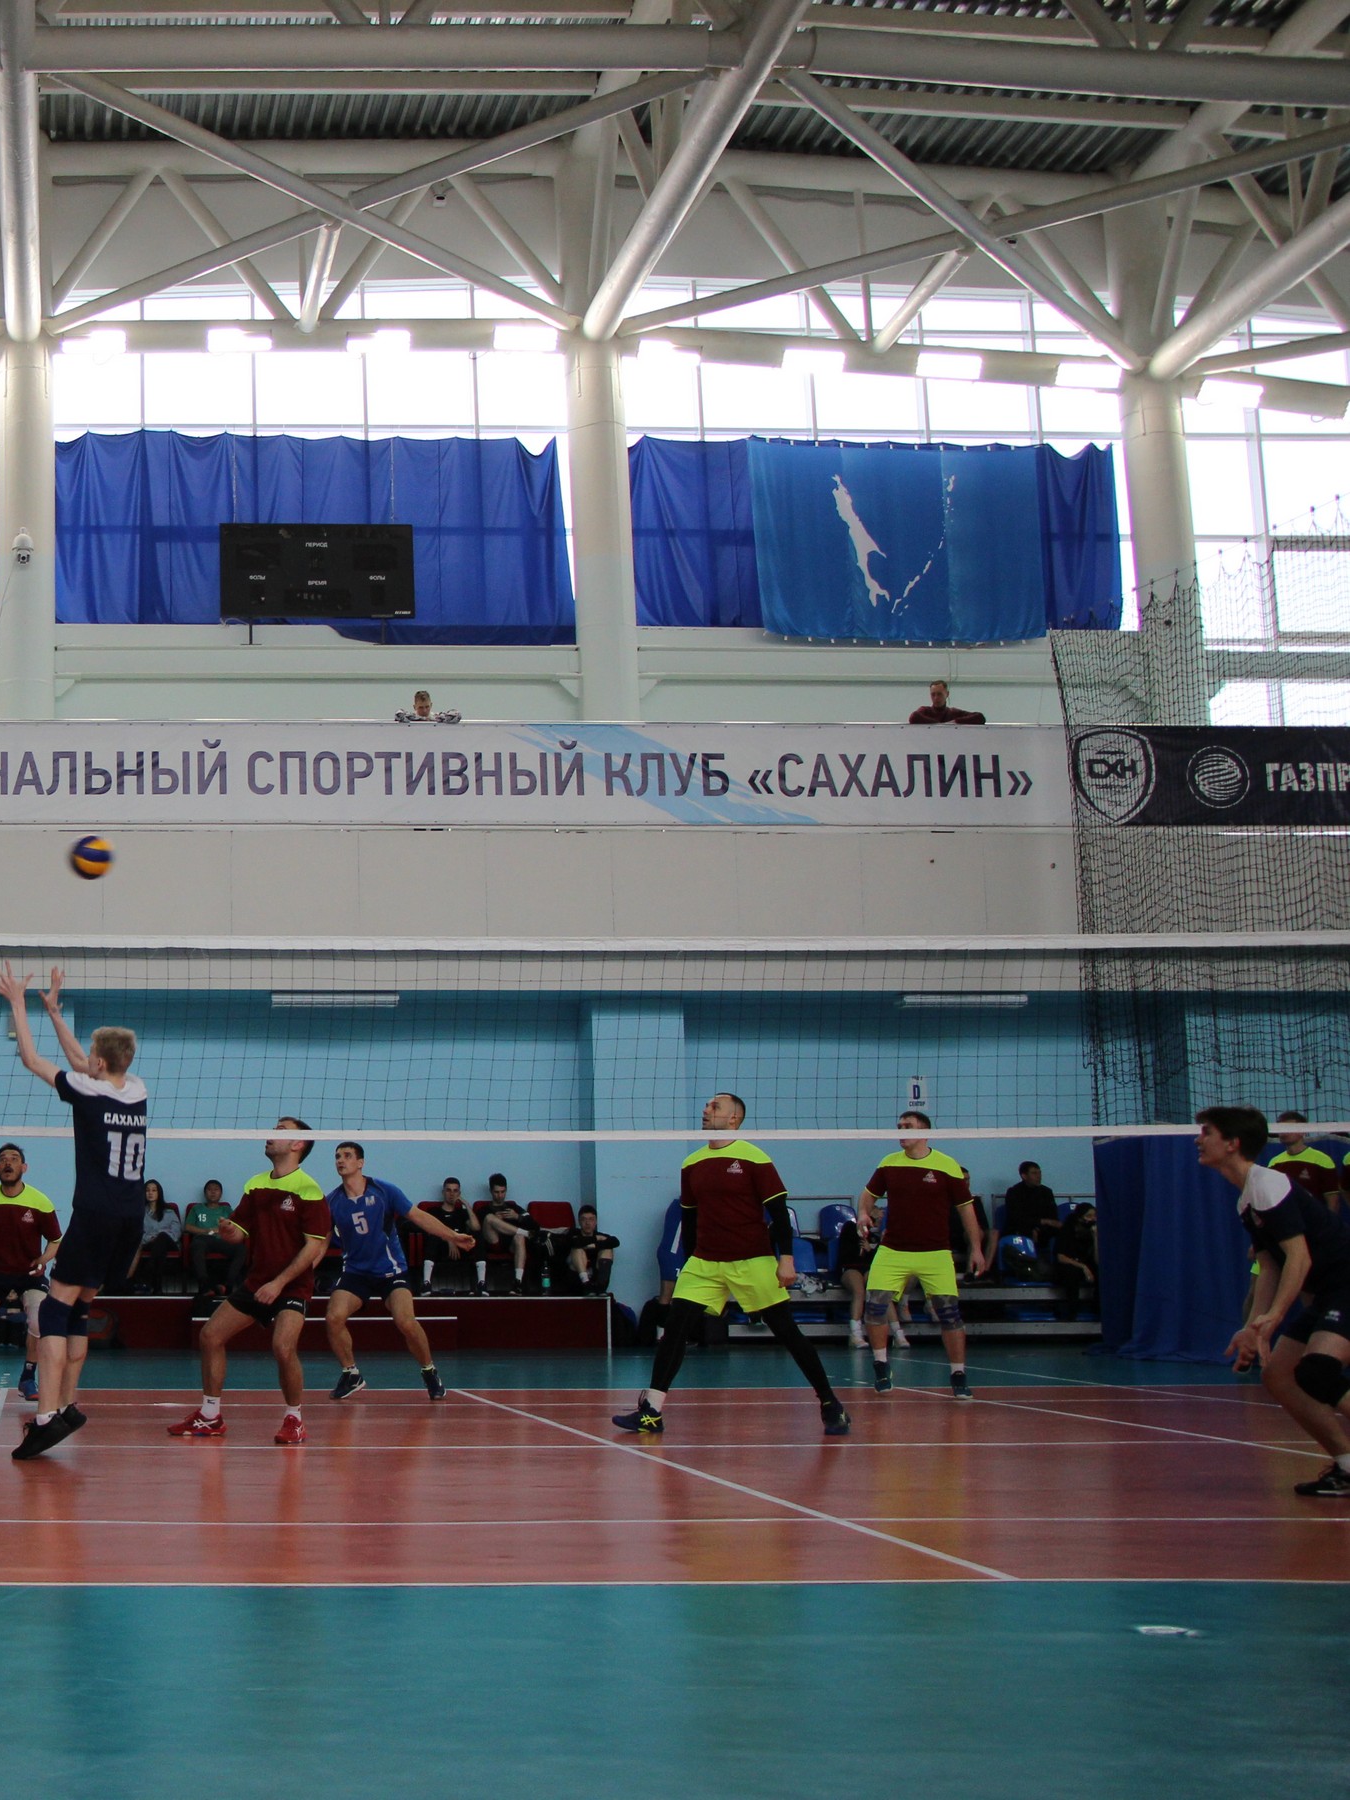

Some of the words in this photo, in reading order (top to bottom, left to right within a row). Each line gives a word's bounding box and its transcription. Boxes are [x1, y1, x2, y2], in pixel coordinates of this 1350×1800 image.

[247, 740, 584, 797] СПОРТИВНЫЙ
[607, 753, 731, 799] КЛУБ
[748, 752, 1034, 799] «САХАЛИН»
[912, 1084, 921, 1100] D
[104, 1112, 147, 1127] САХАЛИ
[107, 1131, 145, 1181] 10
[197, 1213, 207, 1222] 15
[351, 1211, 369, 1235] 5
